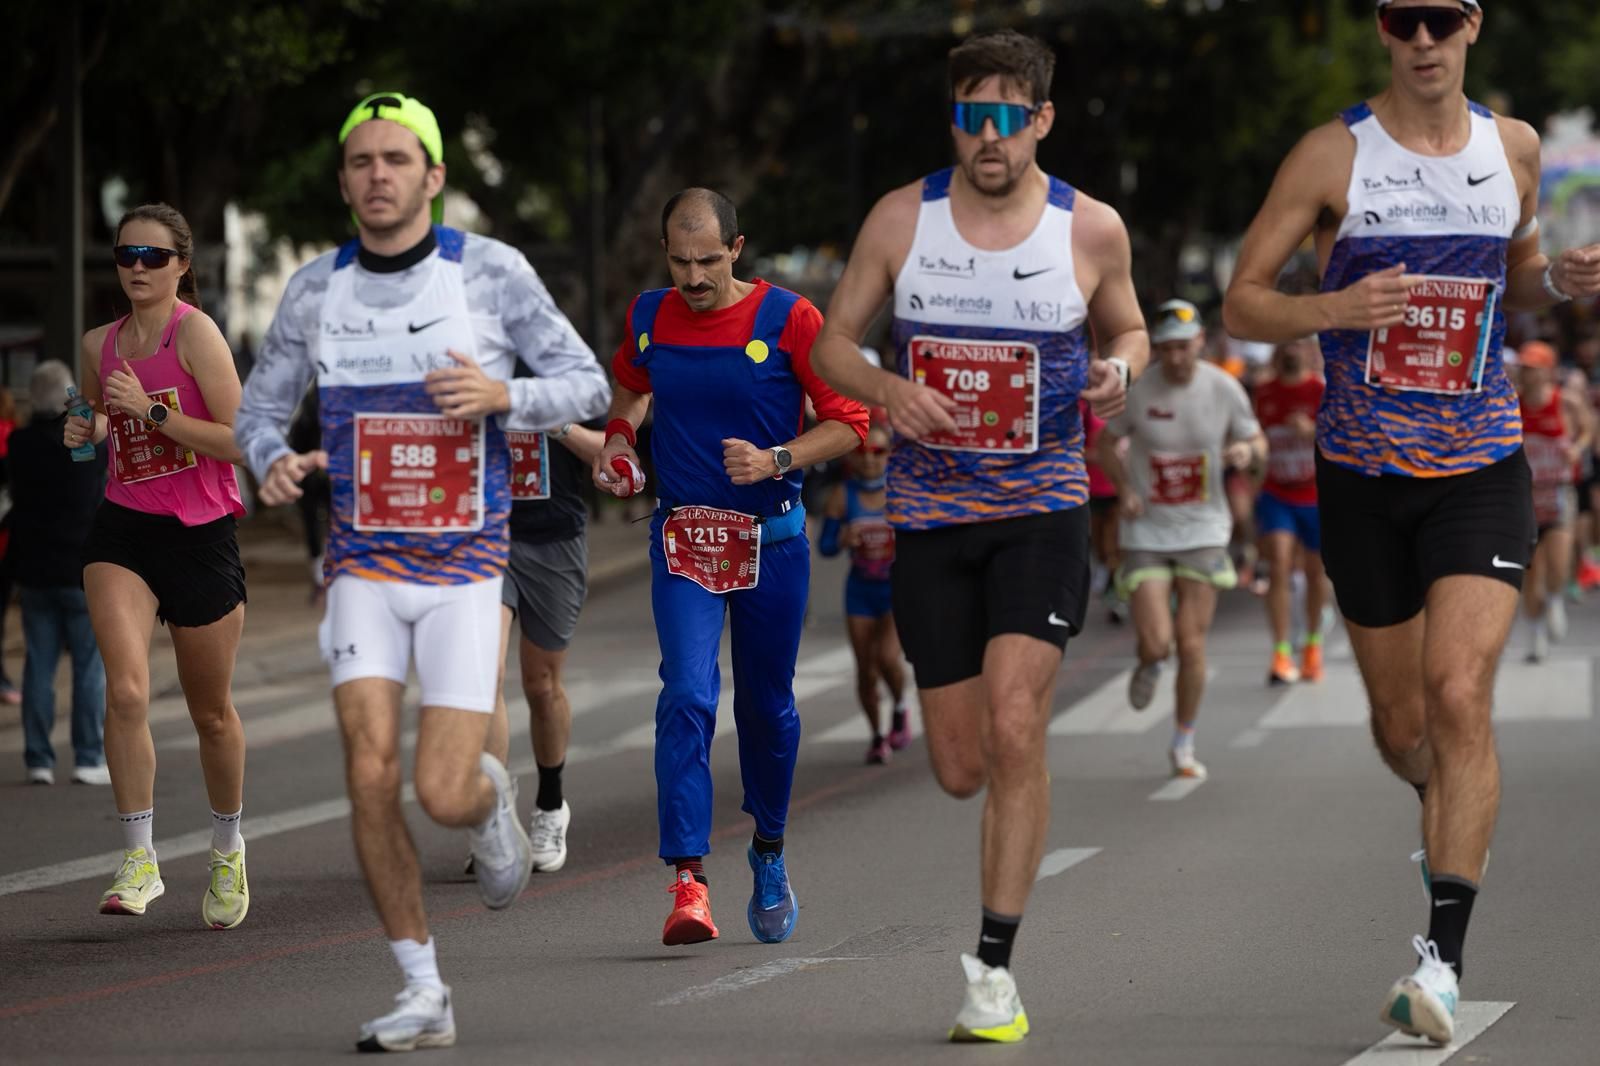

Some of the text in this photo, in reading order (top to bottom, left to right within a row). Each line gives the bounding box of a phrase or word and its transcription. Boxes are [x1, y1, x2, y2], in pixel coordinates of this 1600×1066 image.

[1387, 203, 1448, 218] abelenda
[1410, 280, 1486, 300] GENERALI
[929, 293, 993, 310] abelenda
[1404, 305, 1466, 331] 3615
[943, 368, 991, 392] 708
[385, 420, 465, 437] GENERALI
[390, 444, 438, 468] 588
[688, 508, 745, 523] GENERALI
[684, 527, 729, 544] 1215
